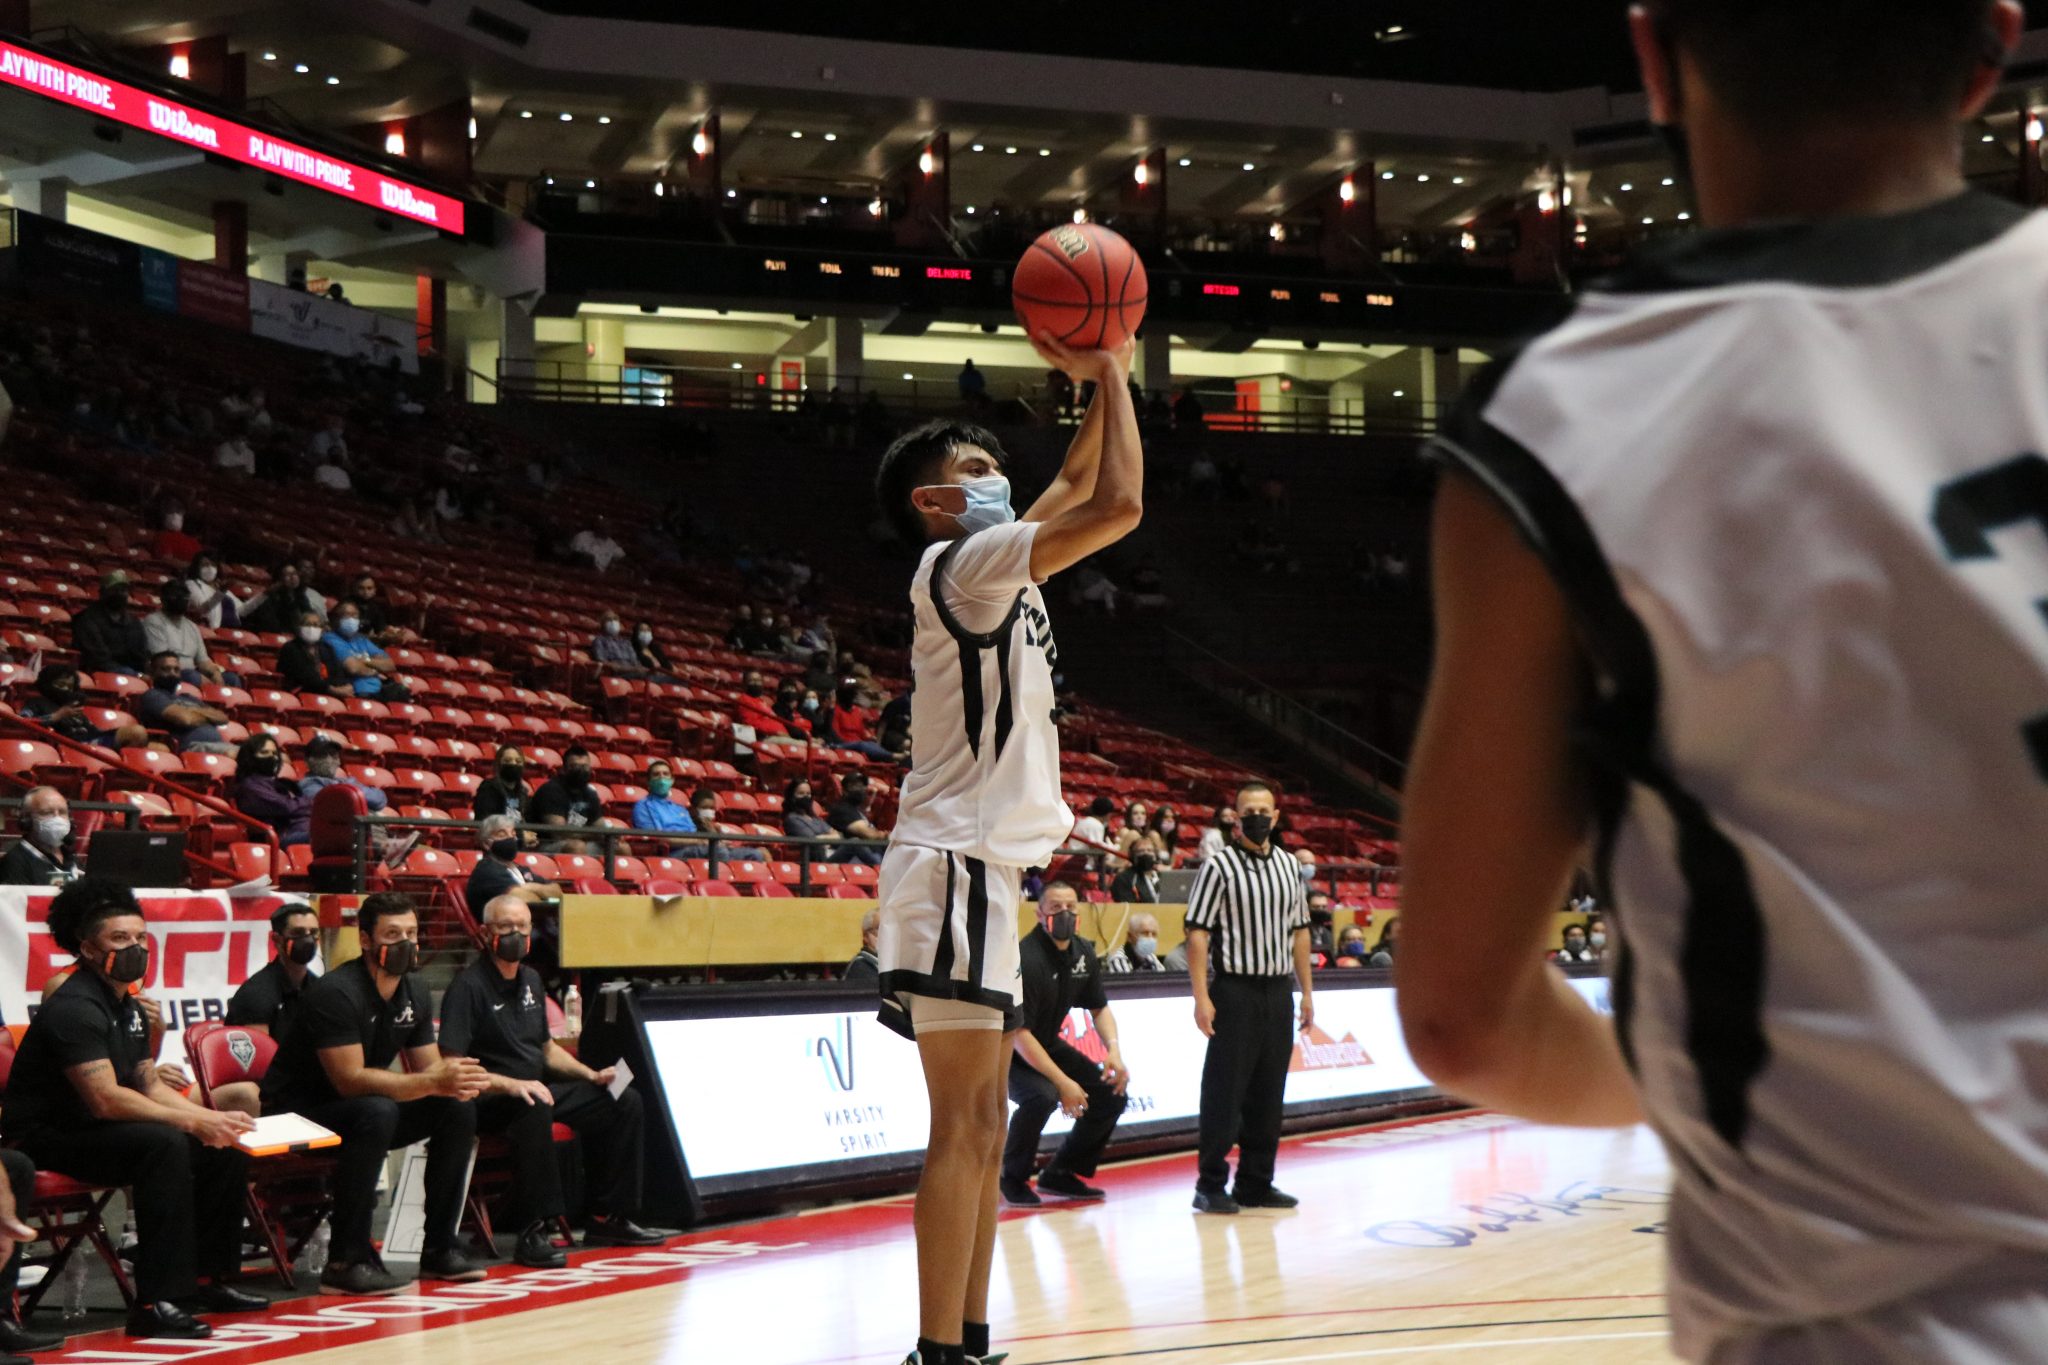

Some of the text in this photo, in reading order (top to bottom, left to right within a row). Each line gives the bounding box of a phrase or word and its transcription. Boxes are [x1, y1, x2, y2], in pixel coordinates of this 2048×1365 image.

[148, 99, 220, 147] Wilson
[379, 180, 438, 221] Wilson
[824, 1105, 885, 1127] VARSITY
[840, 1131, 888, 1153] SPIRIT
[33, 1239, 811, 1365] LBUQUERQUE
